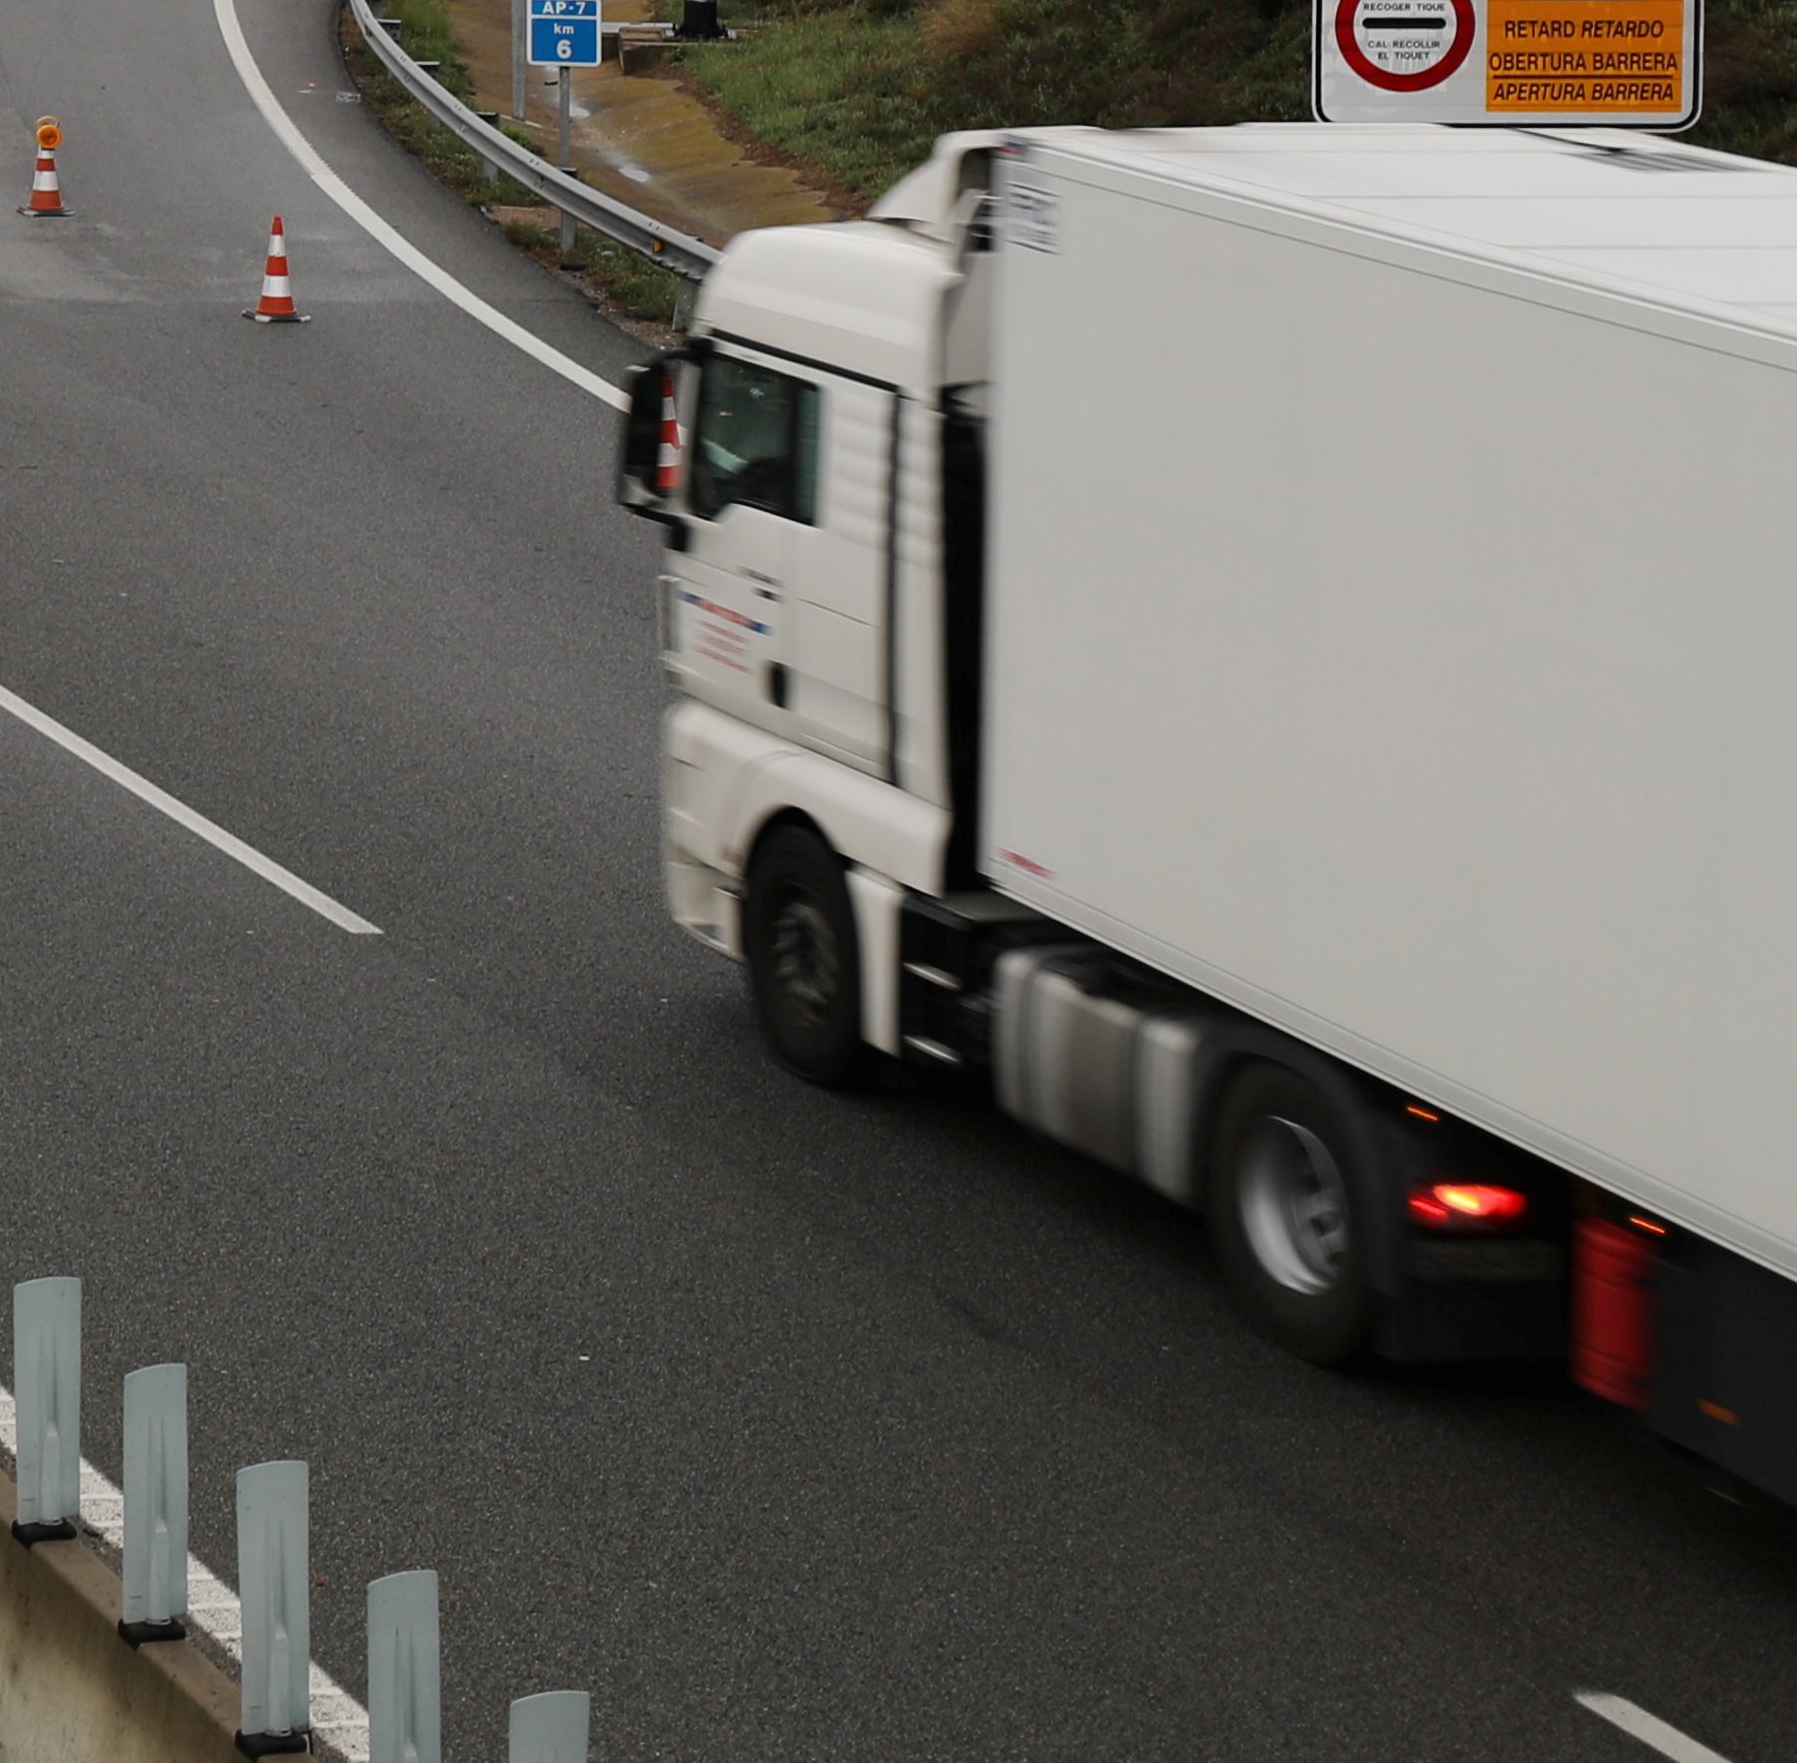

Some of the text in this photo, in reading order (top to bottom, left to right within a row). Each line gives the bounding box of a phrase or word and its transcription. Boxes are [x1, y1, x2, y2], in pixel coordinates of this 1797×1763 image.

[542, 1, 586, 14] AP-7
[1363, 3, 1445, 11] RECOGER TIQUE
[553, 23, 574, 35] km
[1504, 20, 1664, 38] RETARD RETARDO
[556, 39, 572, 59] 6
[1367, 41, 1440, 49] CAL RECOLLIR
[1378, 52, 1430, 61] EL TIQUET
[1489, 53, 1678, 71] OBERTURA BARRERA
[1493, 83, 1674, 101] APERTURA BARRERA
